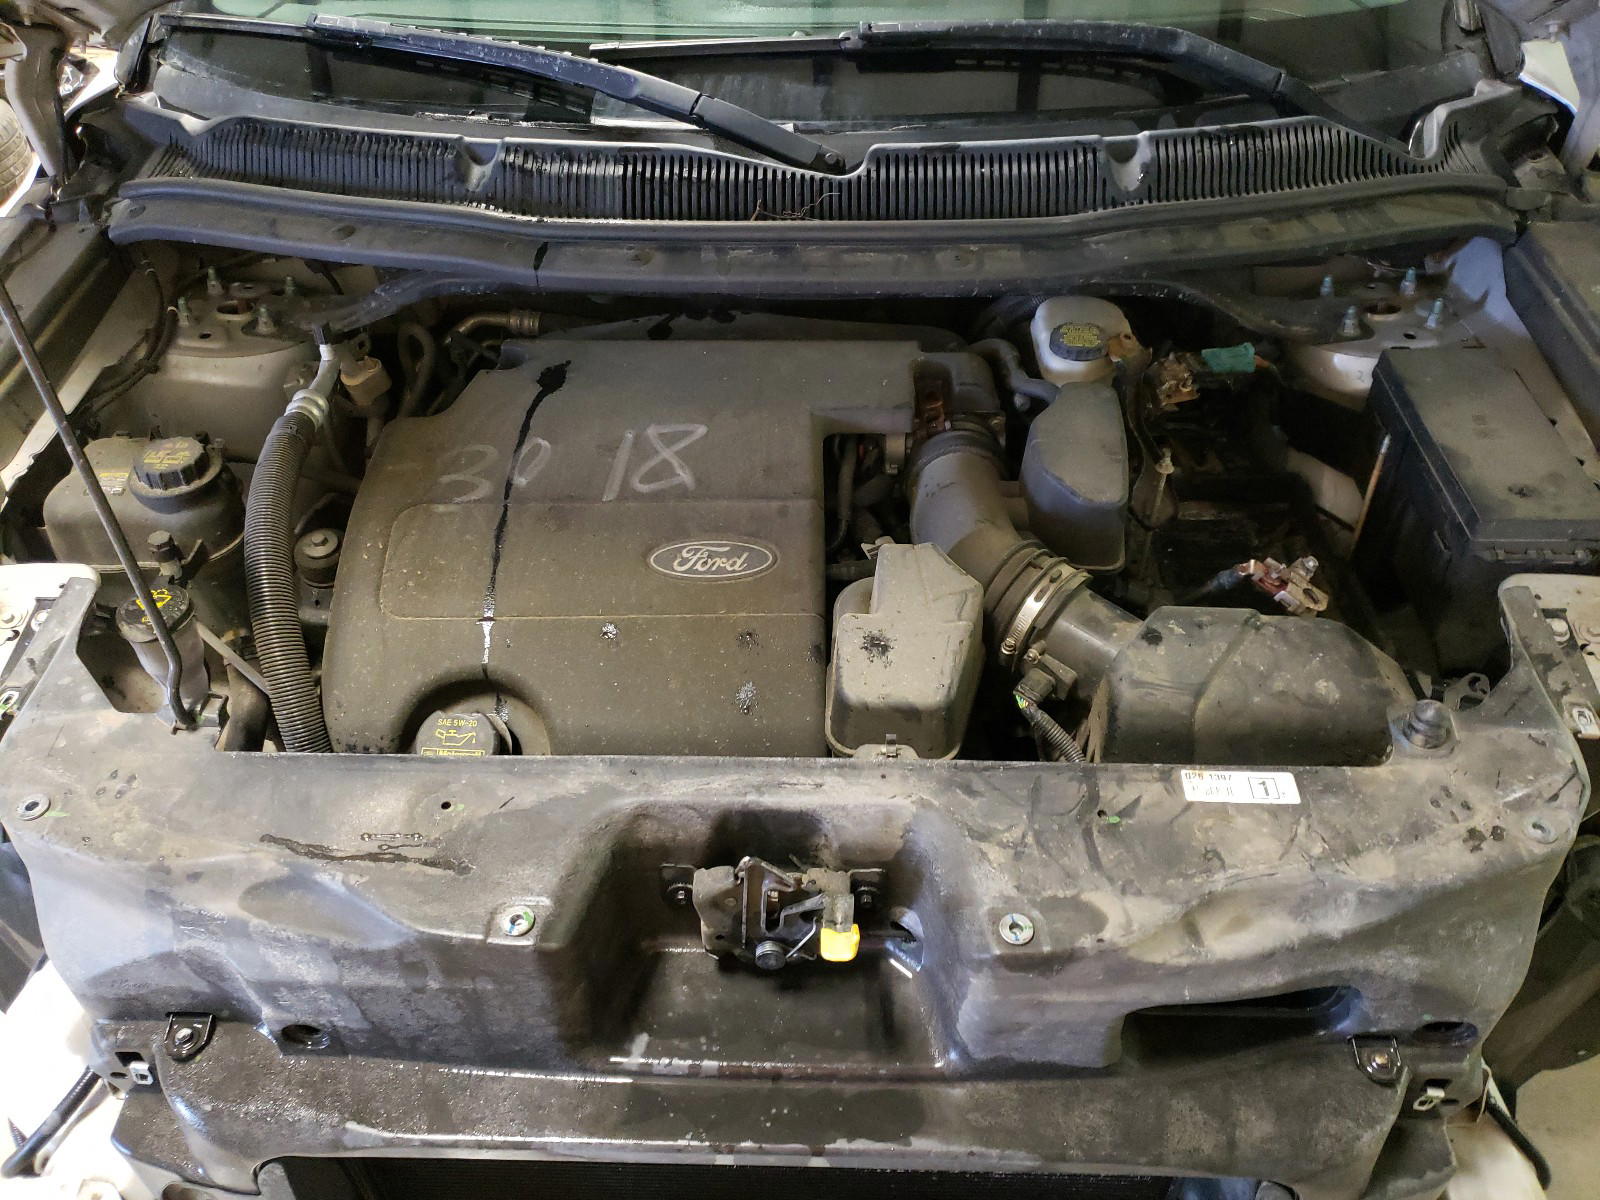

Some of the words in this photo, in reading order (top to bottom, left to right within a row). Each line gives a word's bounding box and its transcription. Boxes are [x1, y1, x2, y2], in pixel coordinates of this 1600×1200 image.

[601, 423, 708, 502] 18
[673, 545, 749, 572] Ford
[438, 718, 452, 726] SAE
[453, 719, 478, 727] 5W-20
[1258, 780, 1270, 797] 1
